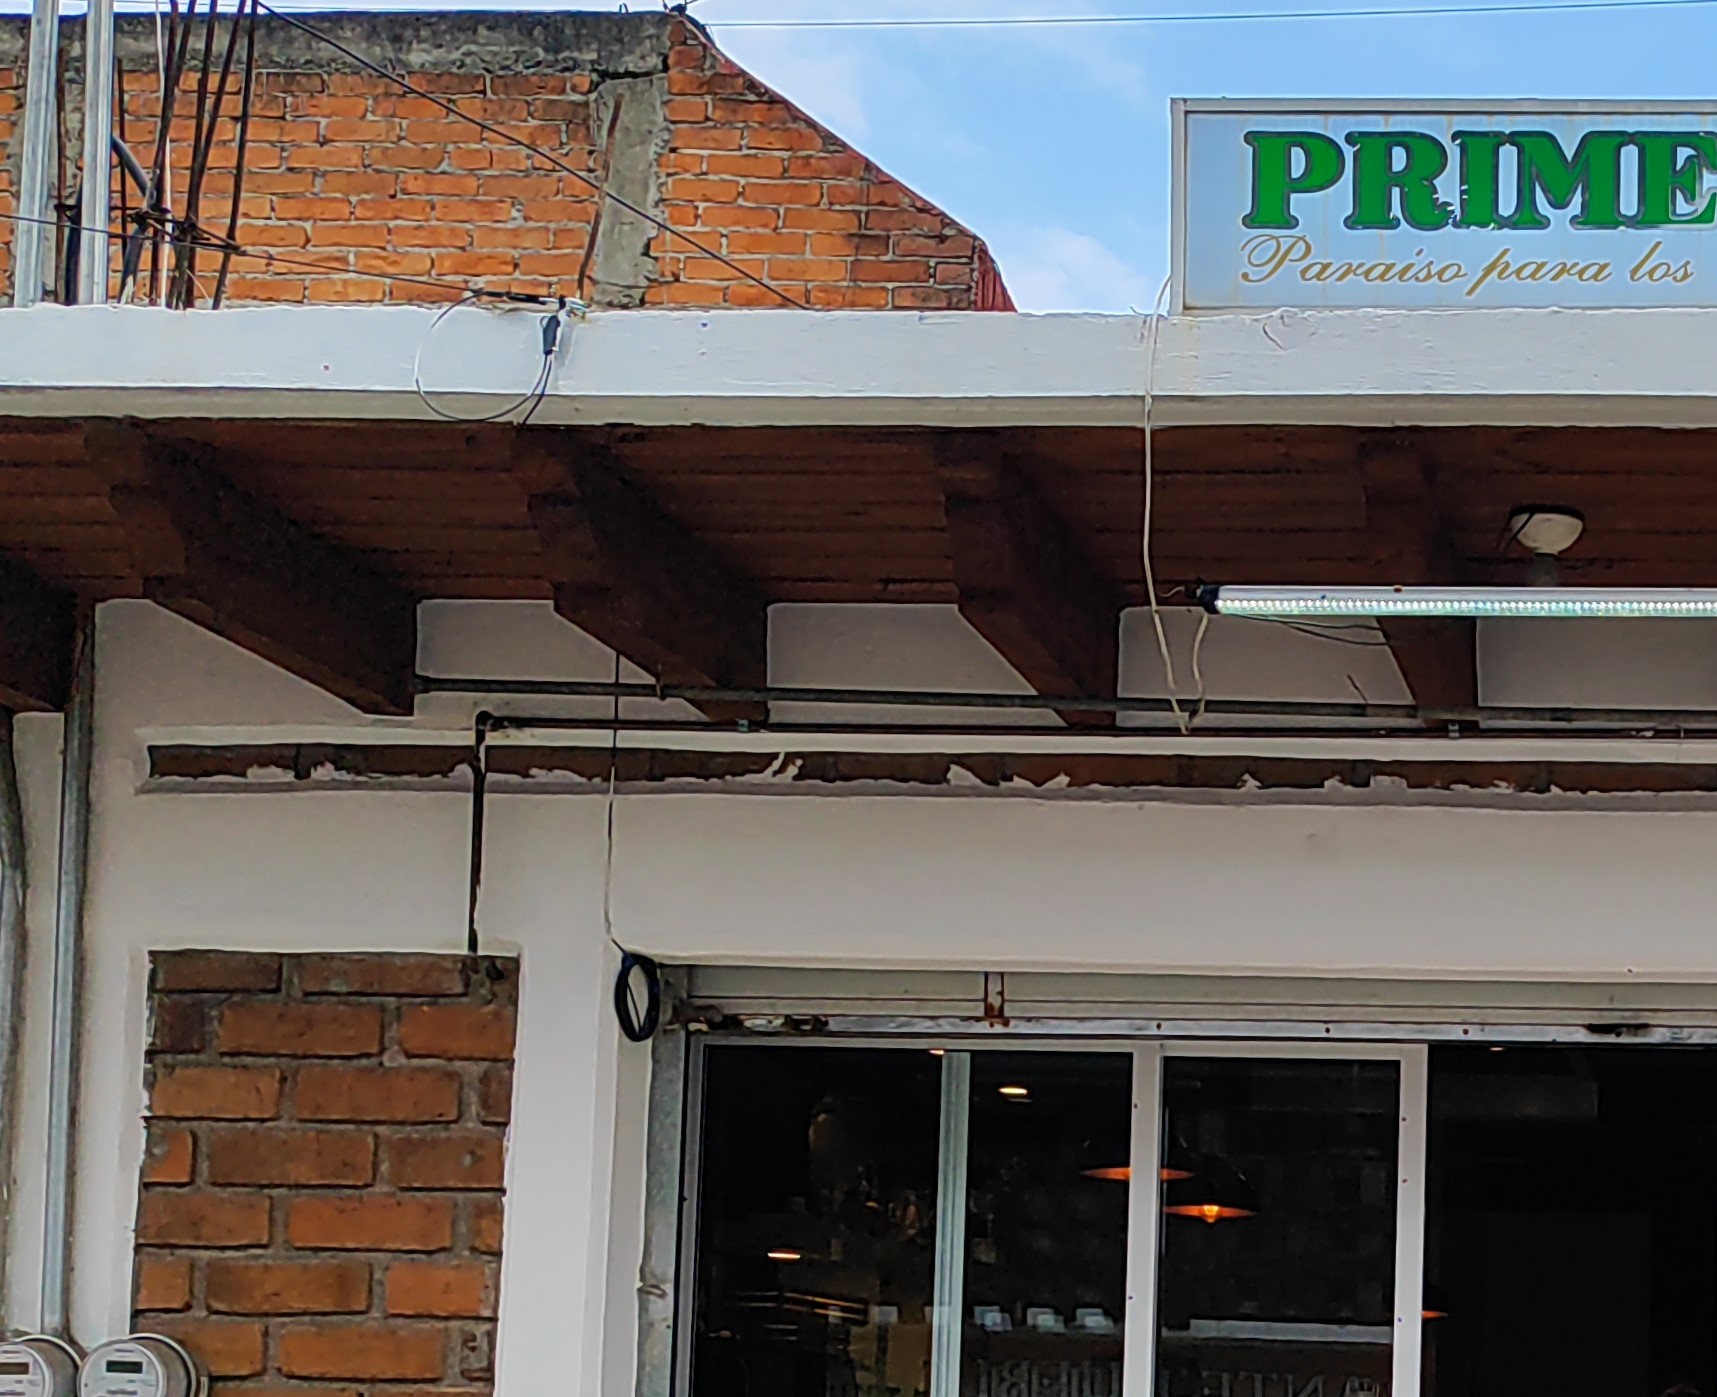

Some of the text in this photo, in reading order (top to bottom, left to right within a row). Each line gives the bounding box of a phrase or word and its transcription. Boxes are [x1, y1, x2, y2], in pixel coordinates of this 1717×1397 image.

[1239, 234, 1468, 285] Paraíso
[1465, 247, 1612, 296] para
[1628, 241, 1694, 284] los
